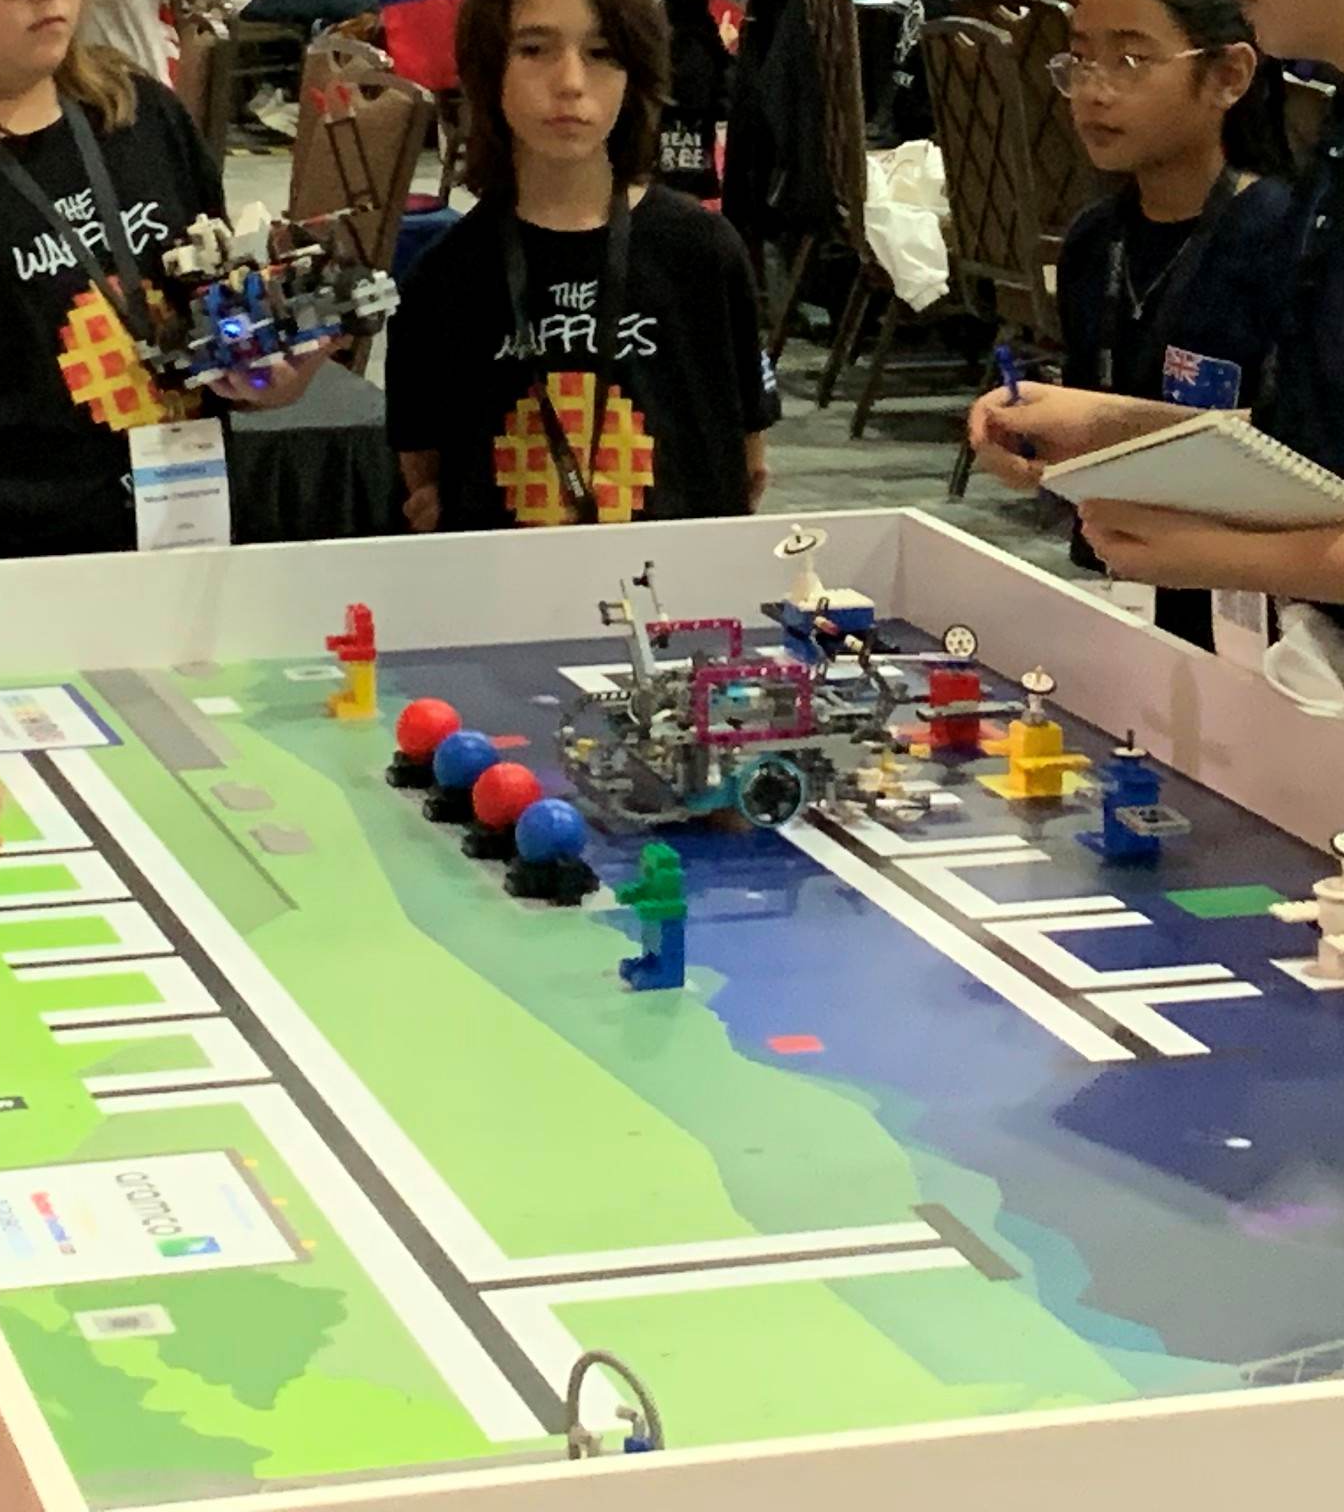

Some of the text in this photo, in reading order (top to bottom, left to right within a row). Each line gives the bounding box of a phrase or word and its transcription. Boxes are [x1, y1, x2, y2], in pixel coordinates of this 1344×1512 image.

[54, 188, 96, 222] THE
[12, 201, 169, 281] WAFLES
[548, 279, 599, 311] THE
[115, 1171, 183, 1236] aramco
